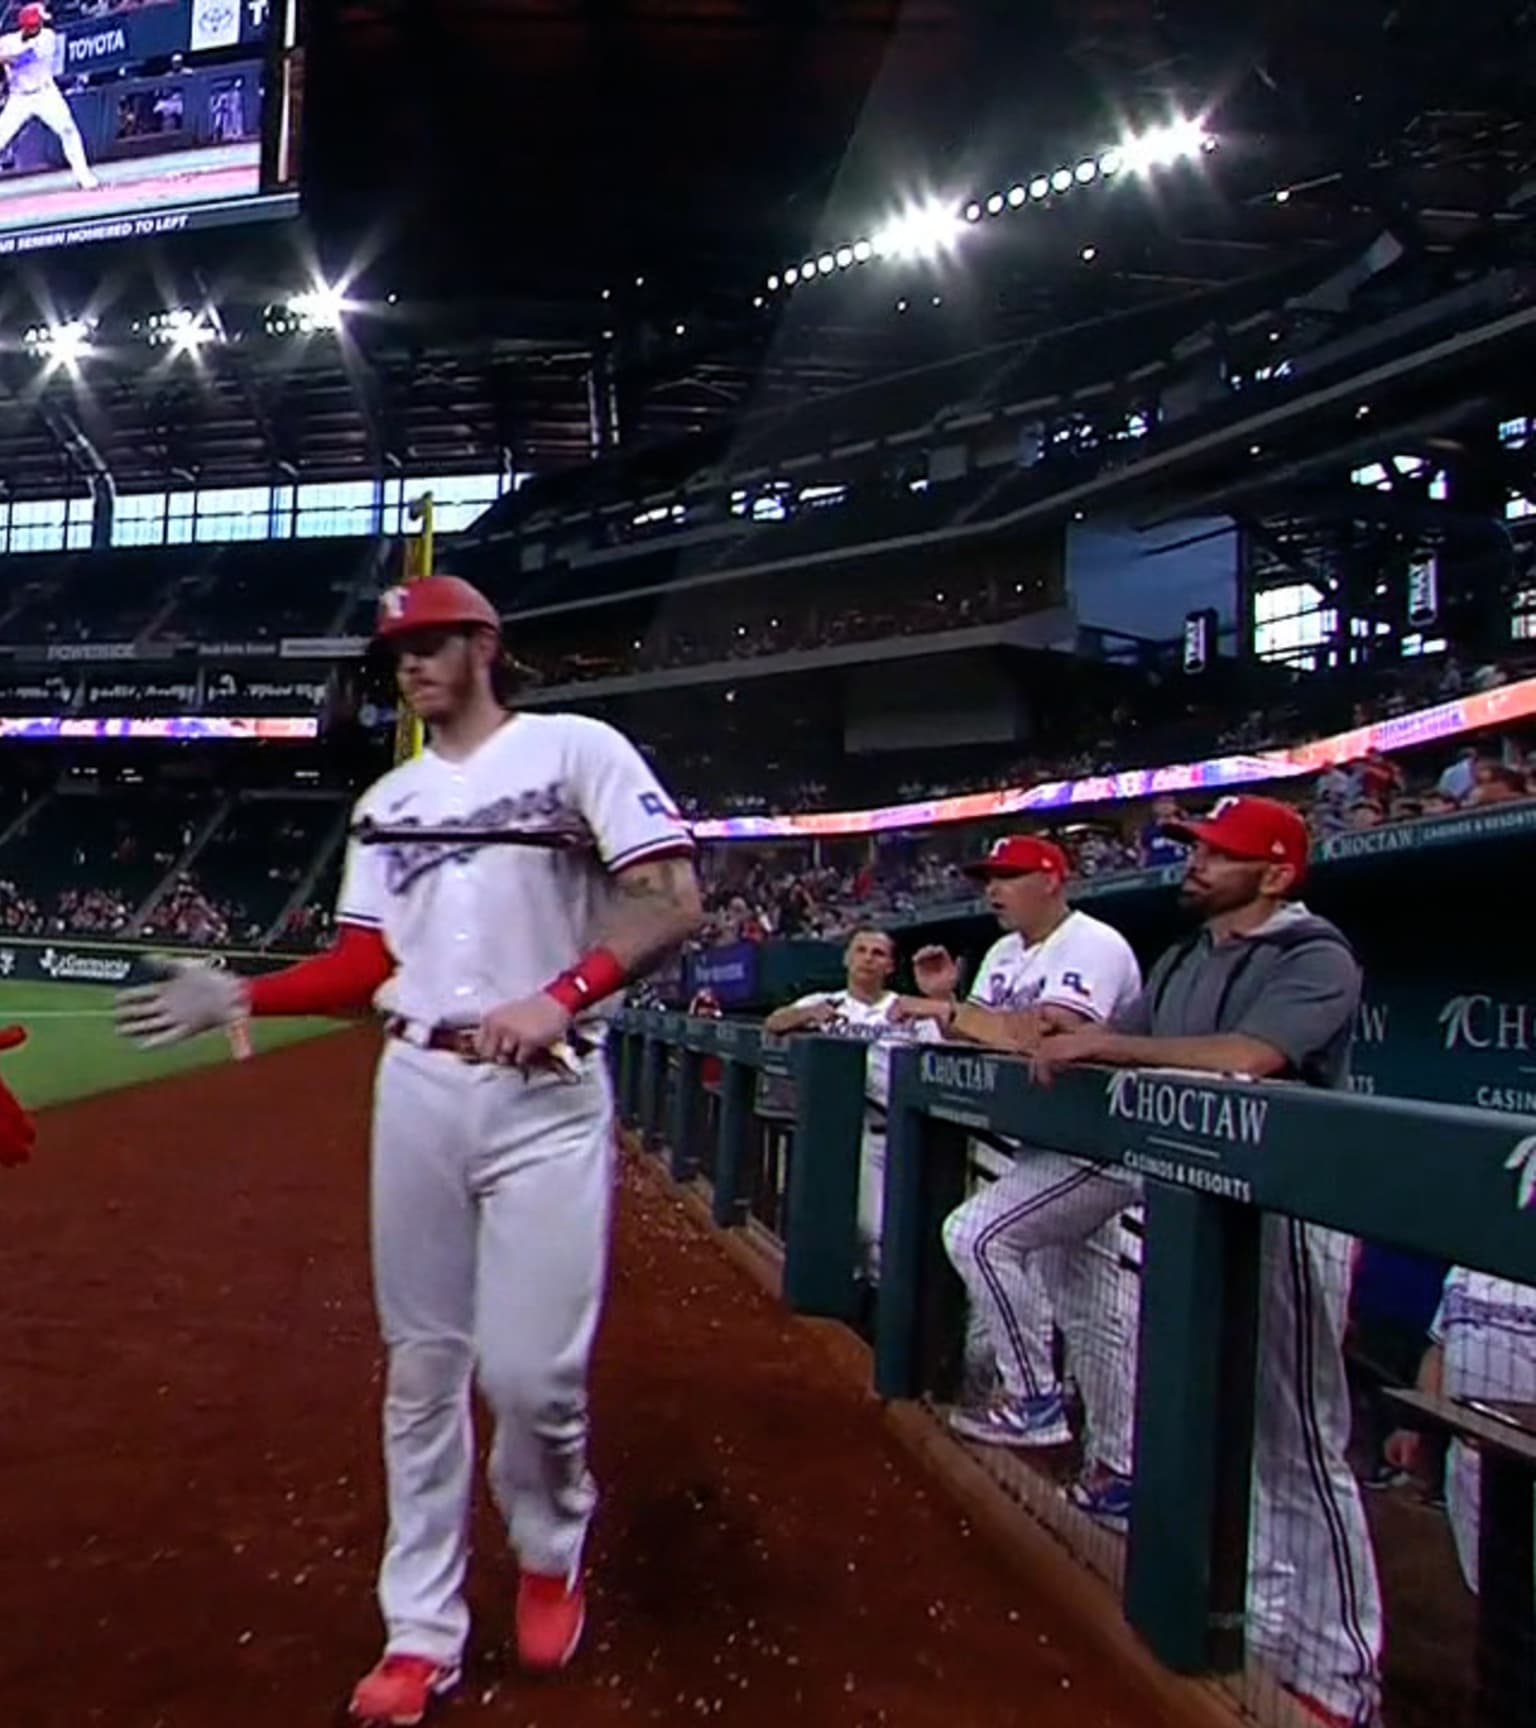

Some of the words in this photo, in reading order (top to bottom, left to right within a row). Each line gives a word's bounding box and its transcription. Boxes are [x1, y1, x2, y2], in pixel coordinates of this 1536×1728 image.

[68, 29, 126, 62] TOYOTA
[66, 221, 133, 243] HOMERED
[135, 219, 154, 234] TO
[155, 214, 189, 231] LEFT
[1330, 828, 1413, 859] CHOCTAW
[924, 1051, 999, 1092] CHOCTAW
[1119, 1072, 1268, 1145] CHOCTAW
[1123, 1149, 1174, 1181] CASINOS
[1176, 1164, 1185, 1183] &
[1187, 1166, 1251, 1204] RESORTS
